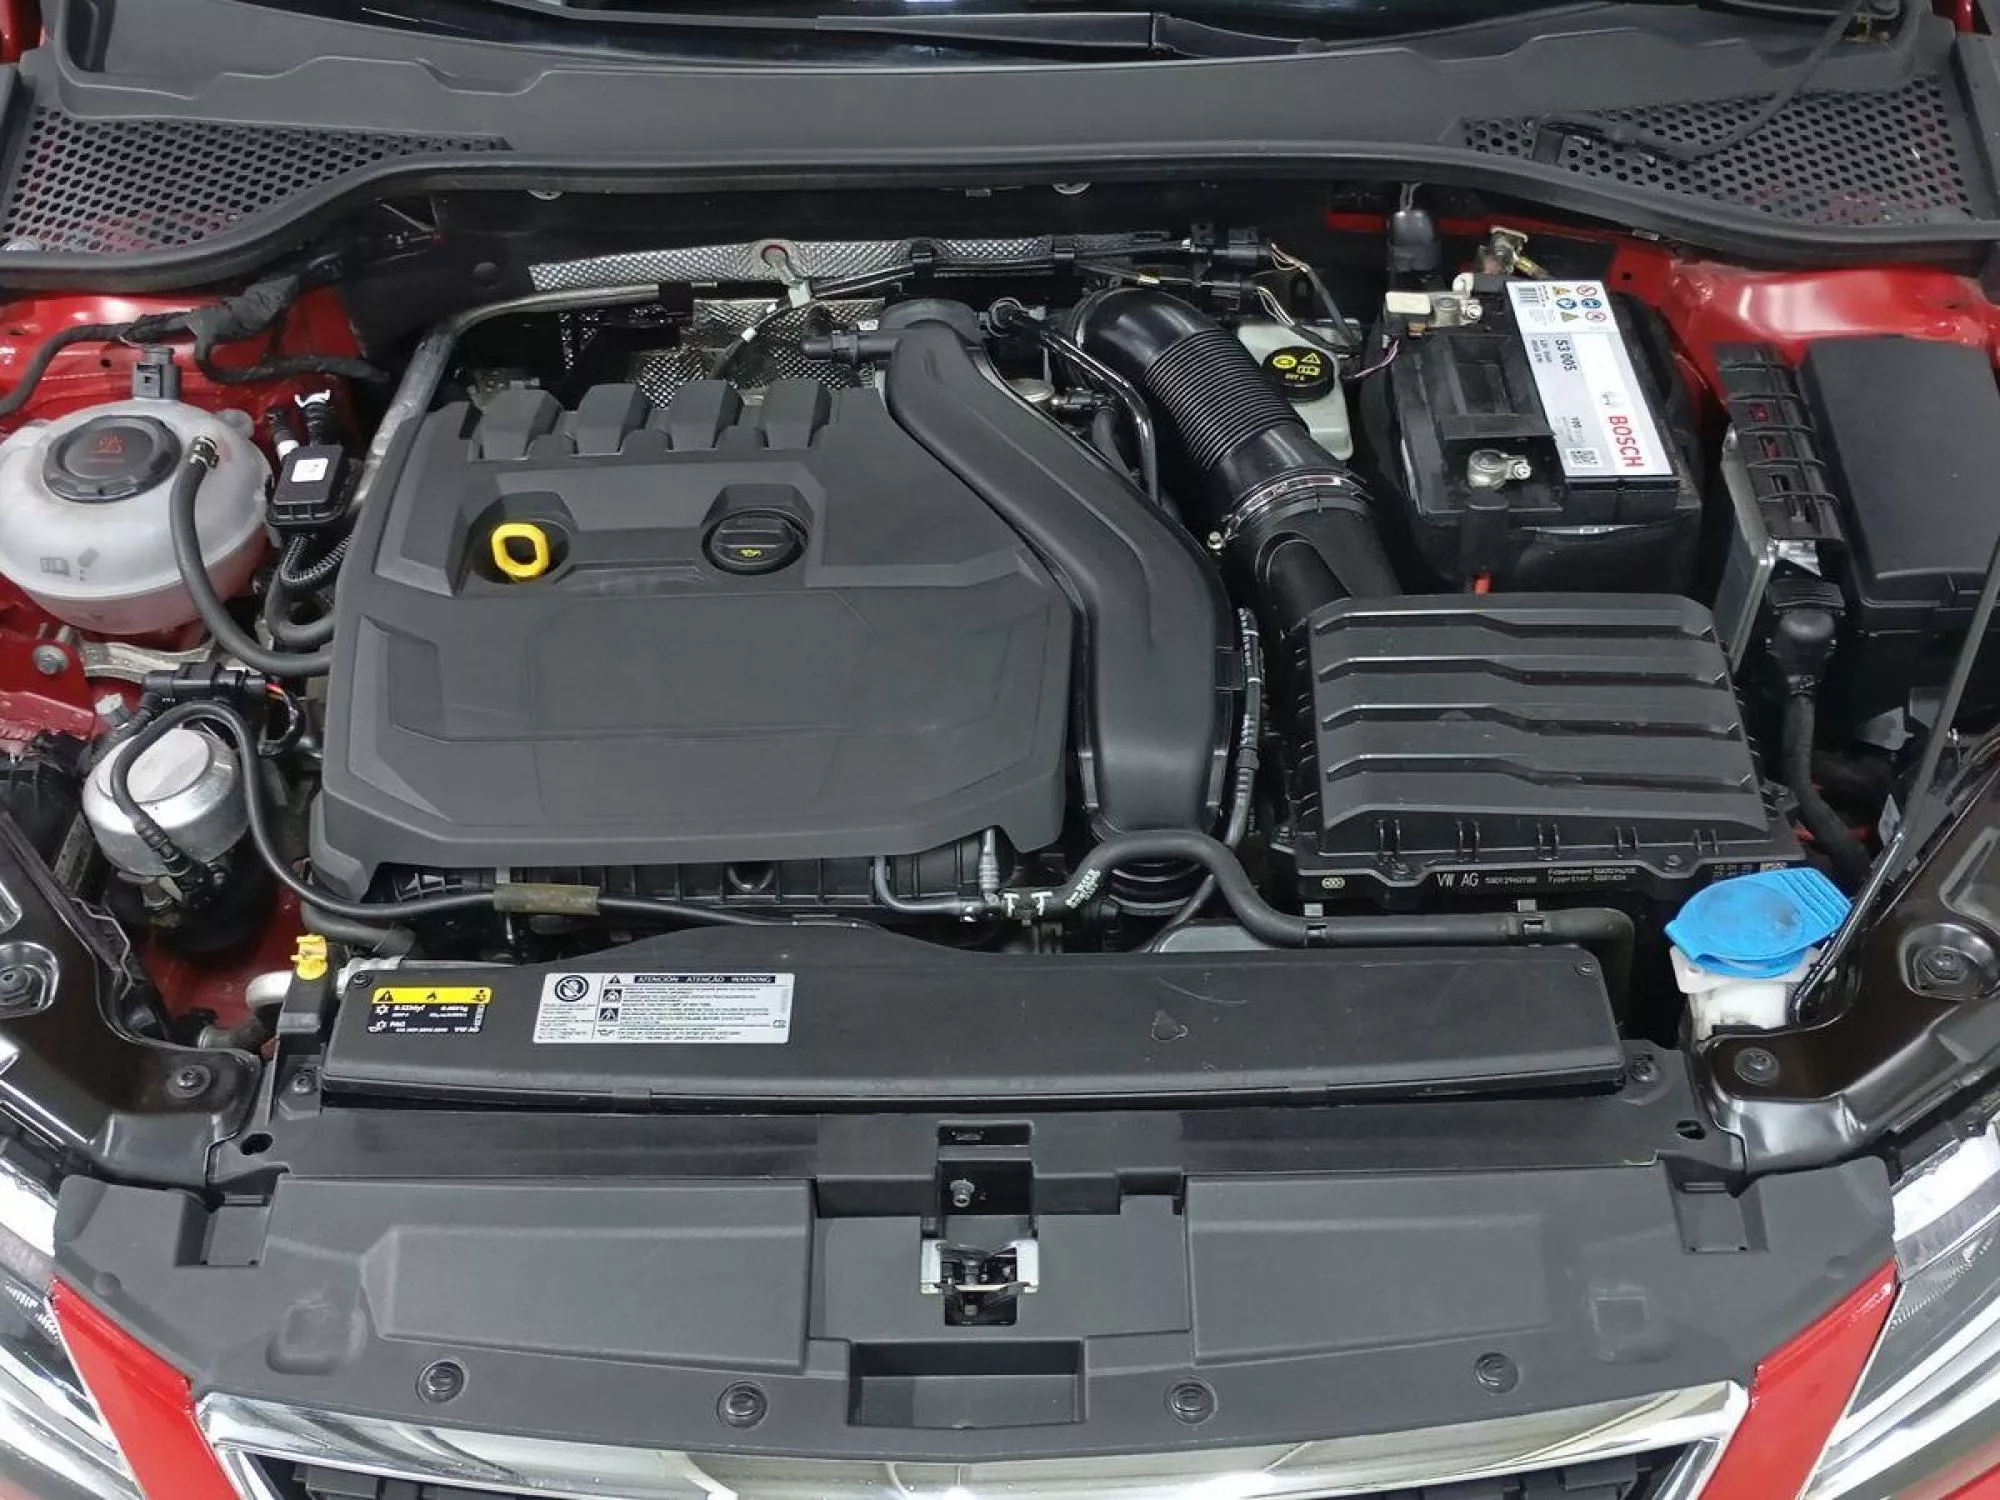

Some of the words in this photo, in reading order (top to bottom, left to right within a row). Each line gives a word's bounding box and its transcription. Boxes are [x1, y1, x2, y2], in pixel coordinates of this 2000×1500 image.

[1608, 415, 1645, 468] BOSCH
[1436, 872, 1456, 888] VW
[1460, 872, 1479, 887] AG
